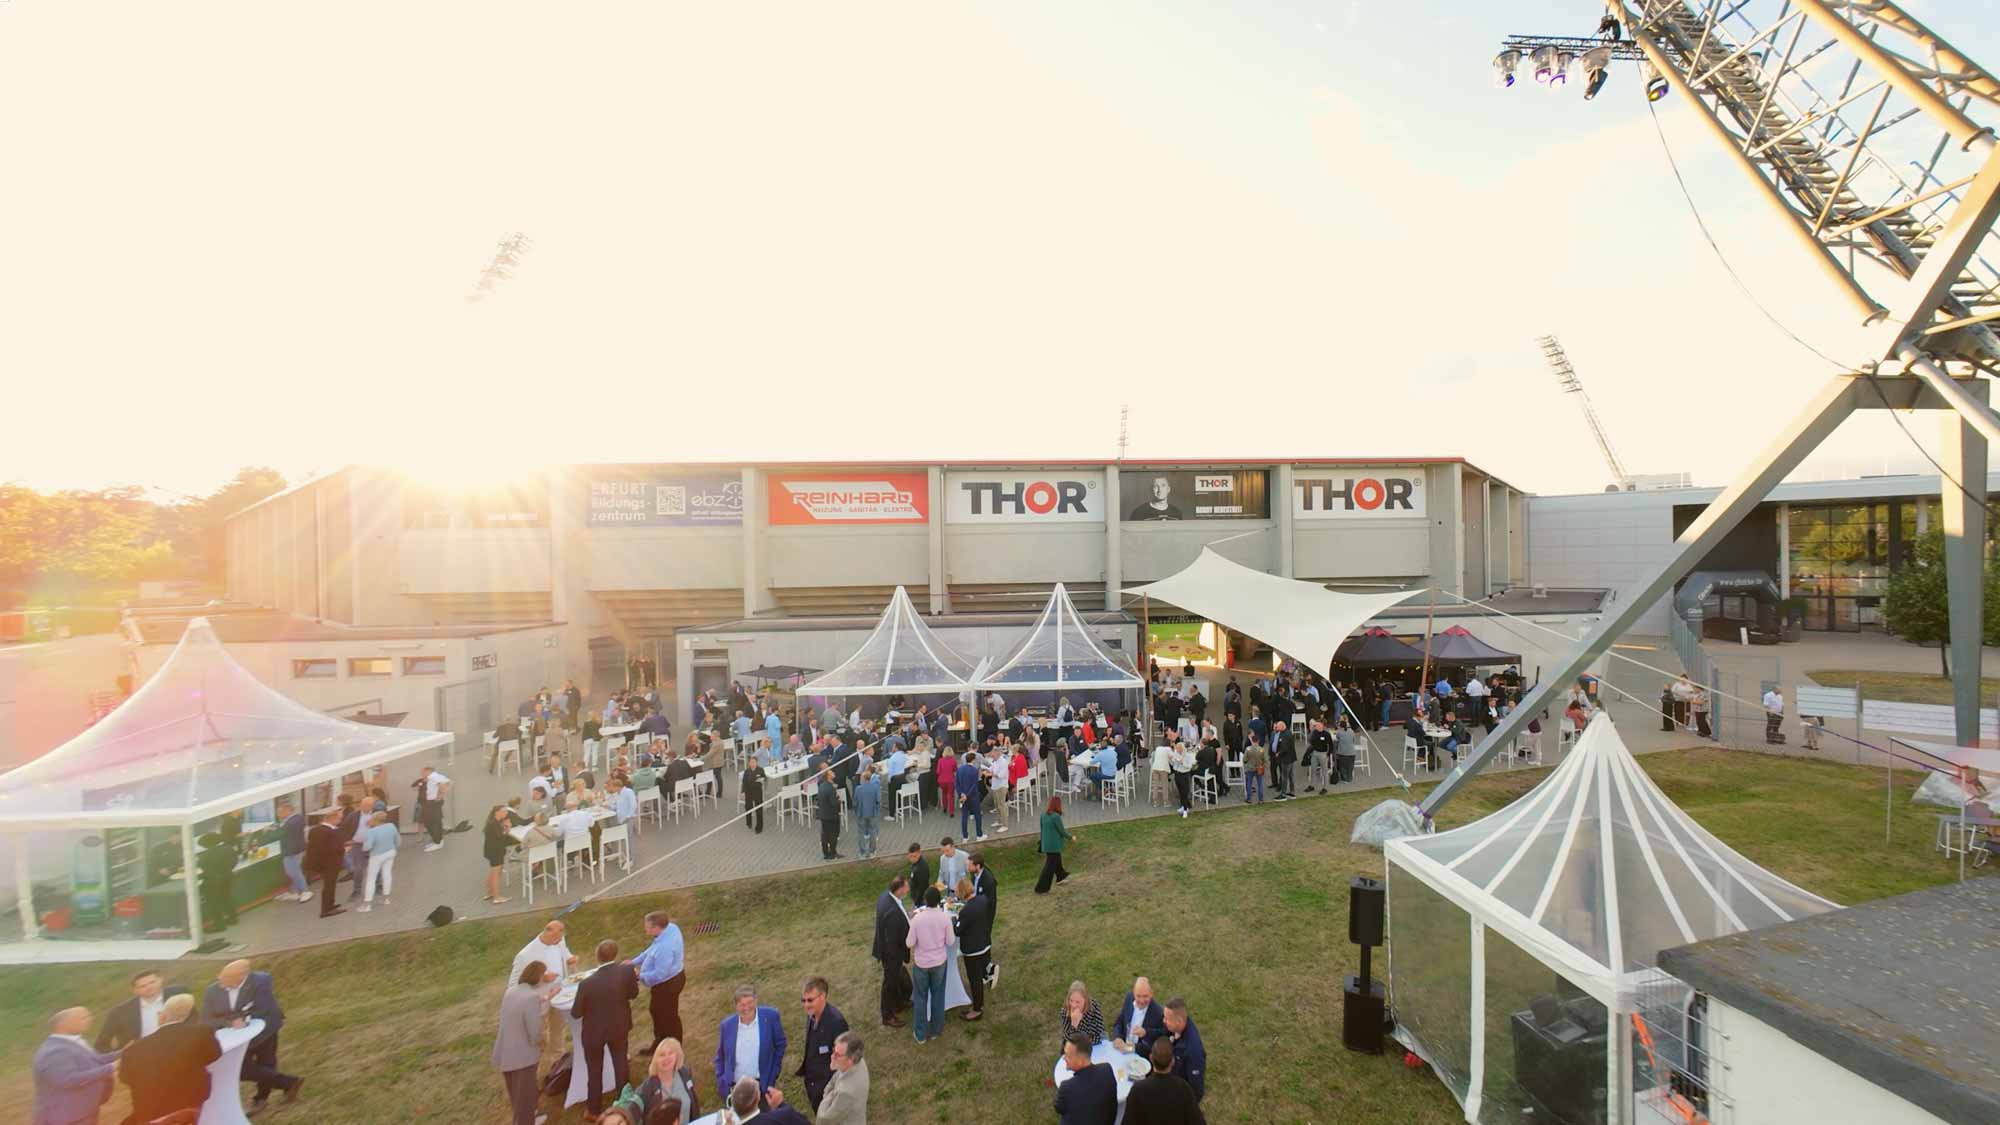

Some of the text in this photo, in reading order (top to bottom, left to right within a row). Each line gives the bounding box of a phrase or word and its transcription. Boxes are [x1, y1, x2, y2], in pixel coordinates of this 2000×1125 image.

[1199, 479, 1229, 488] THOR
[691, 490, 726, 507] ebz
[592, 510, 646, 521] zentrum
